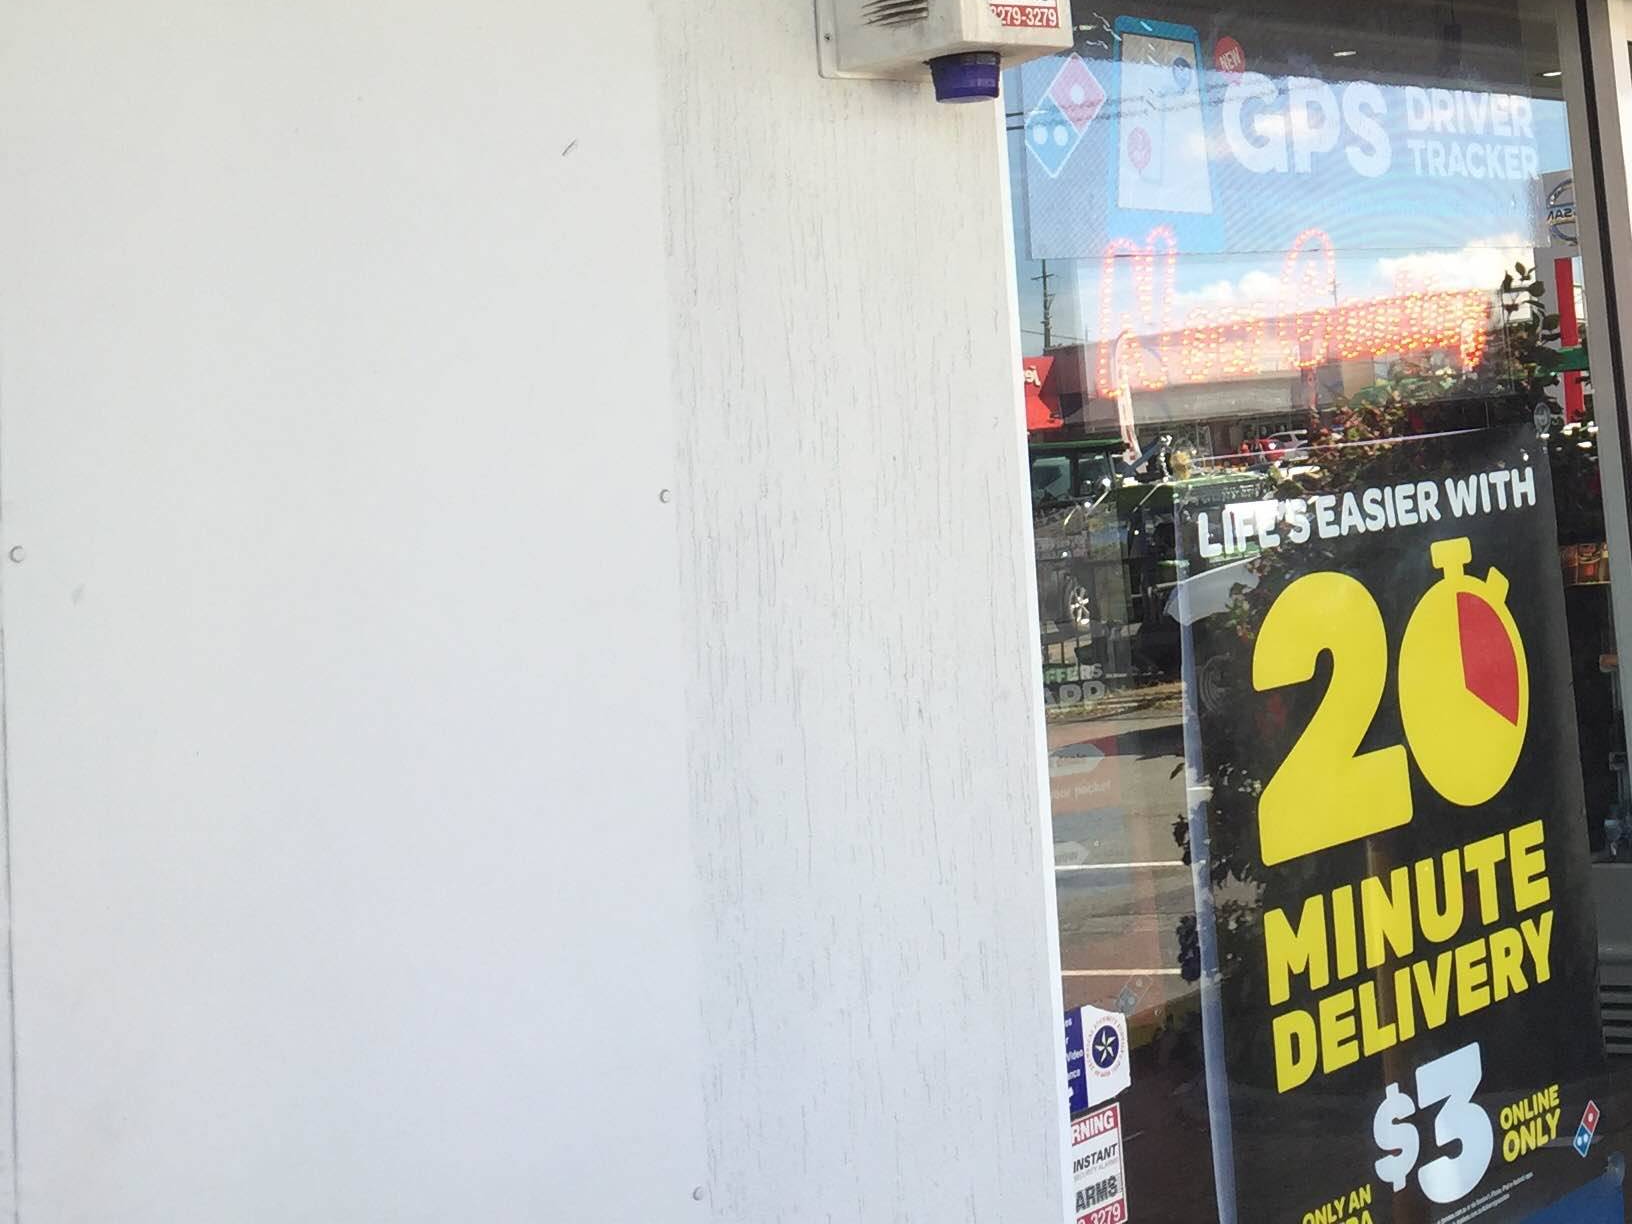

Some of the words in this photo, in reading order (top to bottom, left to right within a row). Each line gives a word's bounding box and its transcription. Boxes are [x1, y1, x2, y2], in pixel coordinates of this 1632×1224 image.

[1219, 46, 1241, 73] NEW
[1222, 71, 1392, 177] GPS
[1404, 86, 1534, 138] DRIVER
[1407, 138, 1540, 180] TRACKER
[1198, 499, 1311, 558] LIFE'S
[1315, 482, 1441, 538] EASIER
[1445, 467, 1536, 518] WITH
[1252, 537, 1530, 868] 20
[1263, 819, 1552, 1007] MINUTE
[1271, 910, 1554, 1094] DELIVERY
[1373, 1042, 1494, 1204] $3
[1499, 1084, 1560, 1131] ONLINE
[1073, 1143, 1118, 1173] INSTANT
[1502, 1109, 1561, 1163] ONLY
[1348, 1183, 1372, 1214] AN
